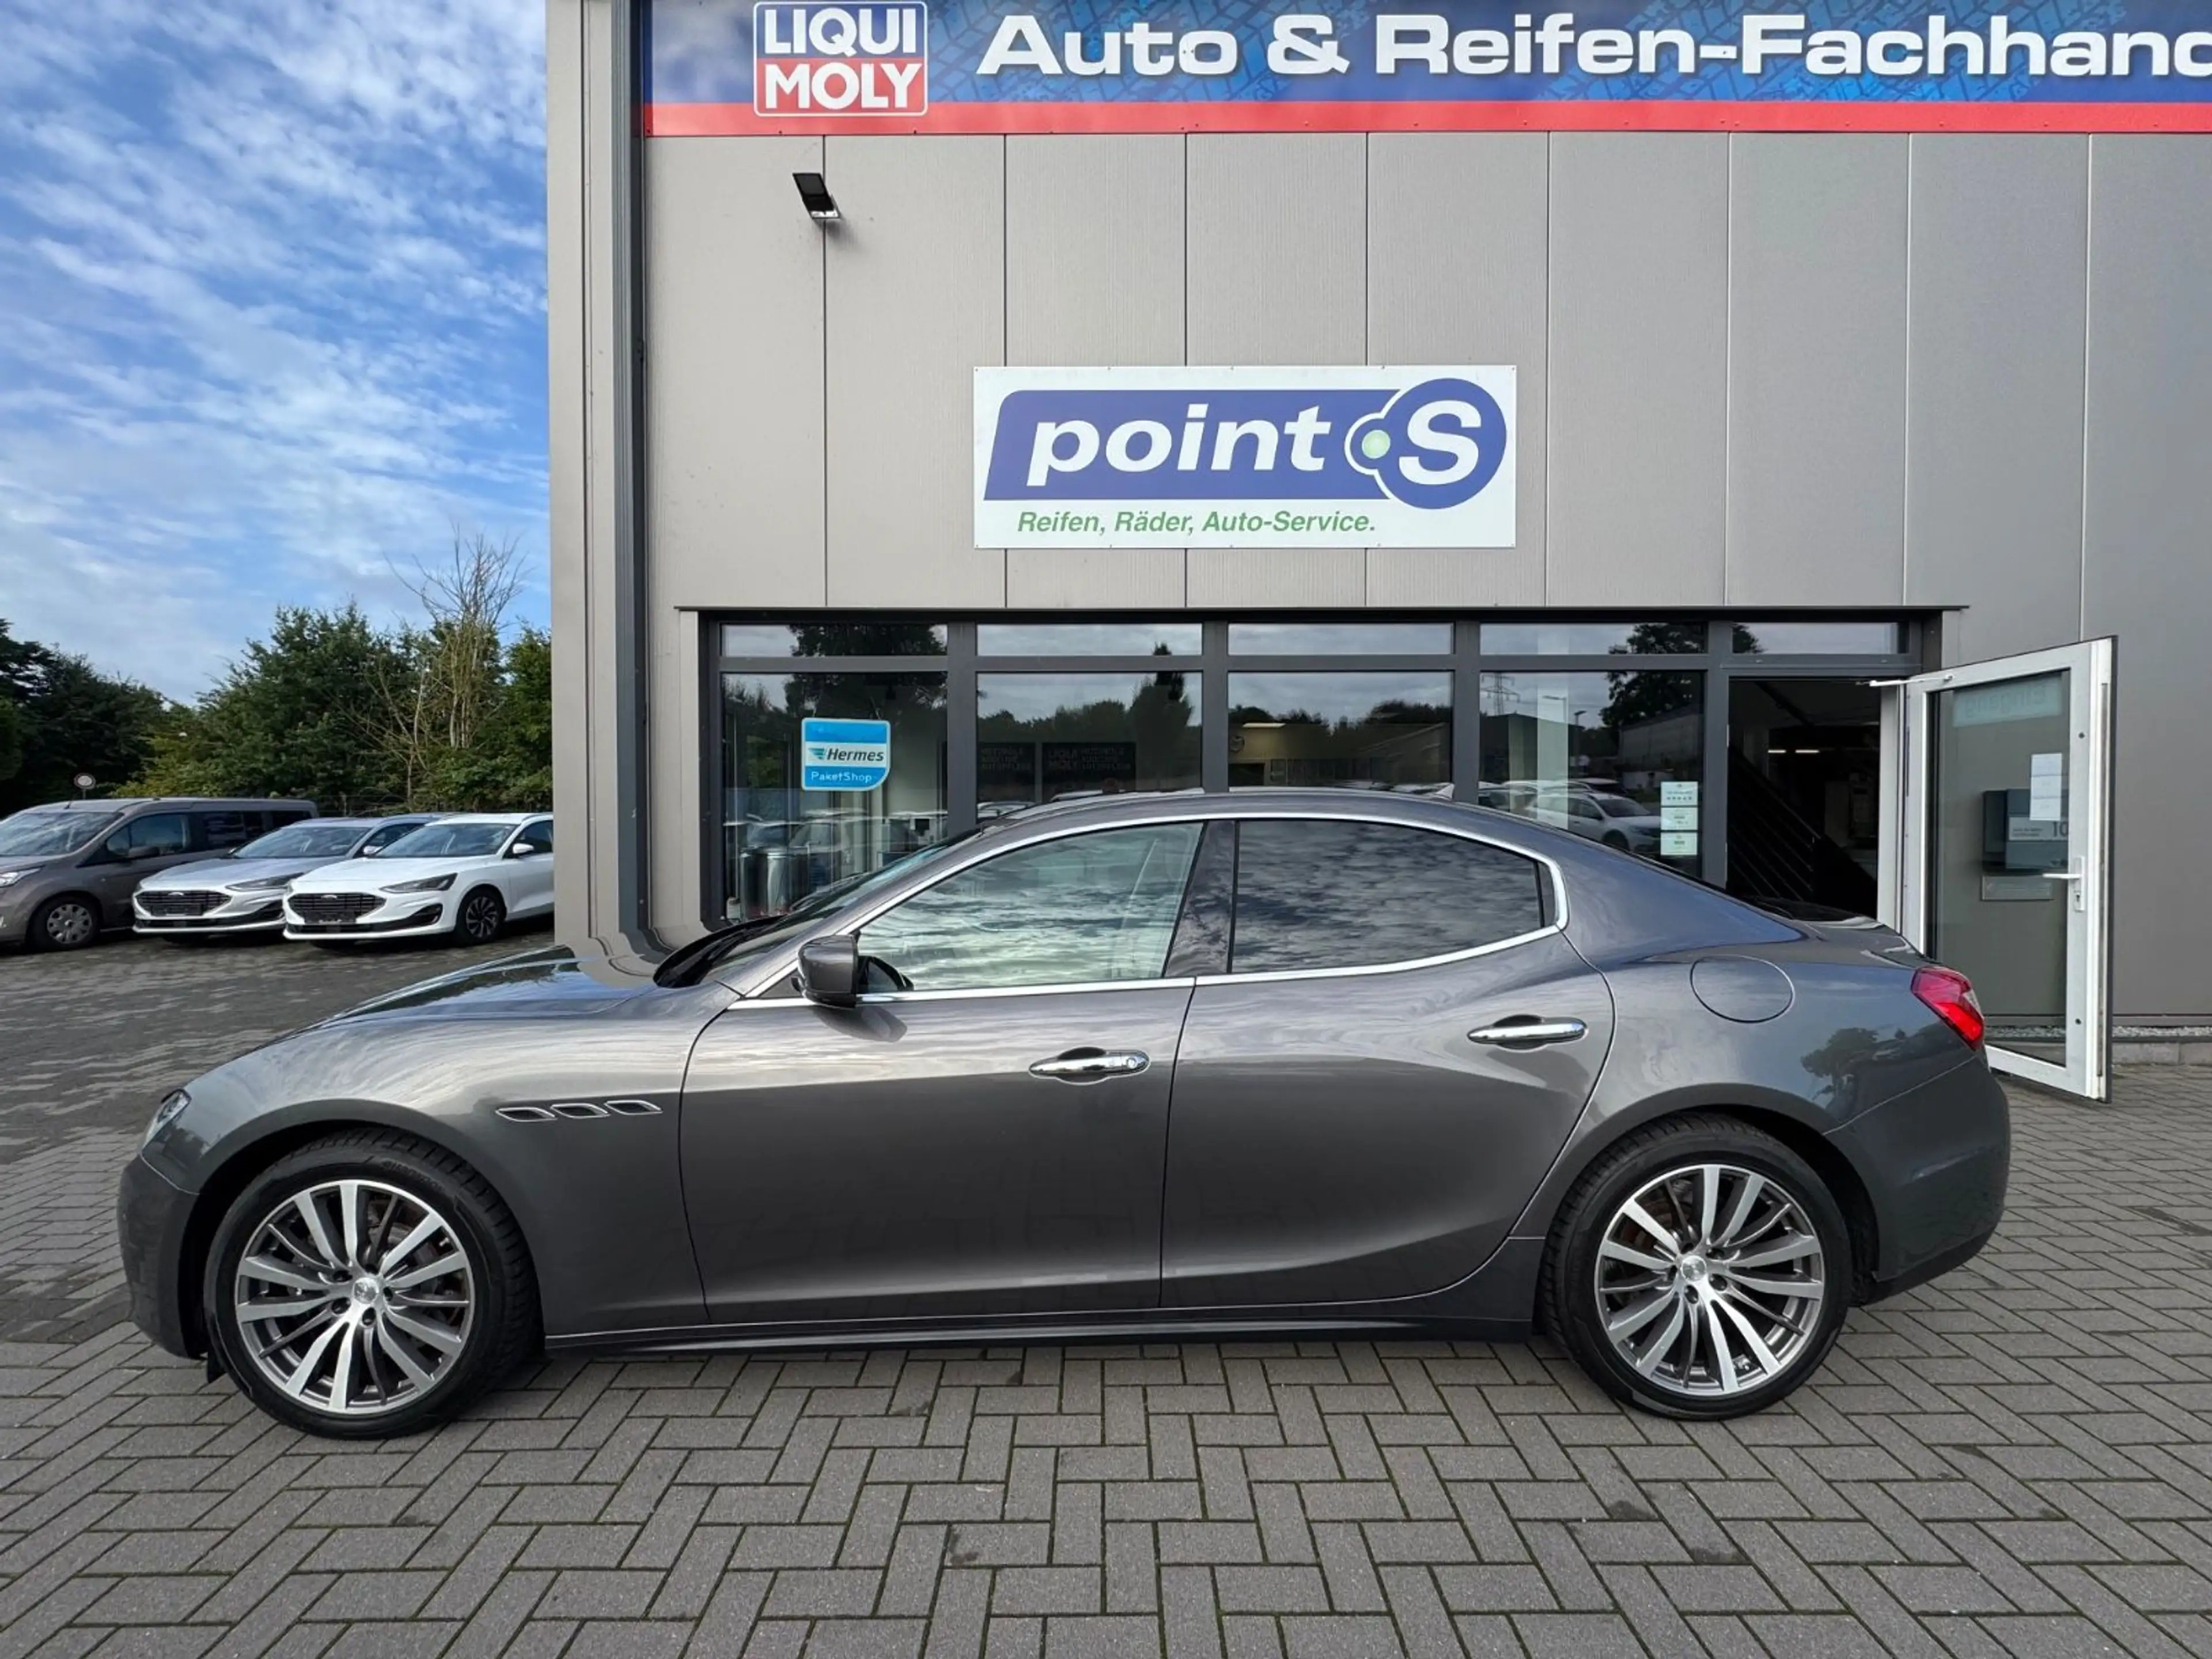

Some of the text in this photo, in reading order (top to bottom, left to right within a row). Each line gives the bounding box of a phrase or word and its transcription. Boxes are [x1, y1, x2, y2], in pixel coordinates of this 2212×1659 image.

[764, 7, 916, 57] LIQUI
[976, 14, 1237, 75] Auto
[1267, 14, 1350, 74] &
[764, 62, 922, 109] MOLY
[1026, 400, 1482, 487] point S
[1017, 510, 1376, 536] Reifen, Räder, Auto-Service.
[811, 771, 872, 784] PaketShop
[826, 748, 884, 762] Hermes
